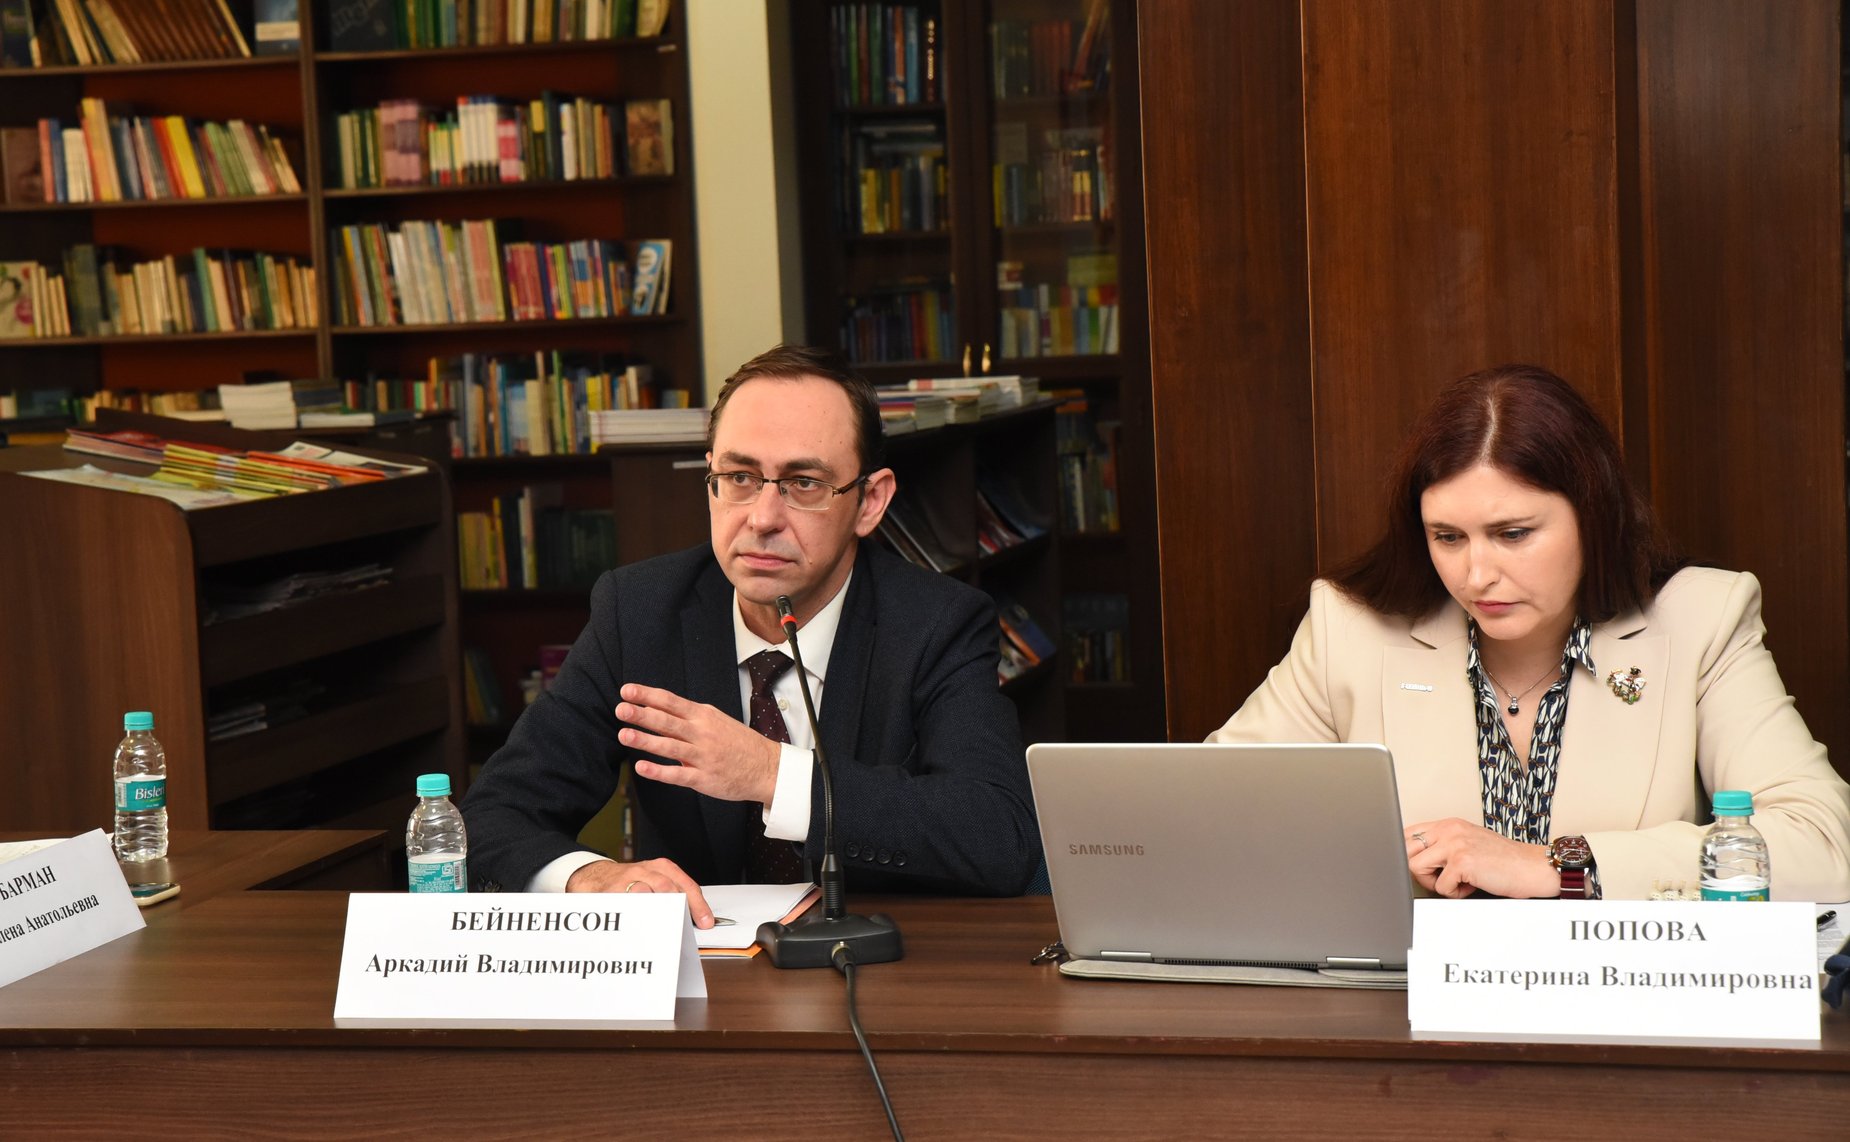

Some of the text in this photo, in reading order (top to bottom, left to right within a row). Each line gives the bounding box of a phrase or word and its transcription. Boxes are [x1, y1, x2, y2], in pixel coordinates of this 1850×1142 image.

[1068, 843, 1145, 856] SAMSUNG
[0, 865, 57, 901] БАРМАН
[25, 894, 99, 933] Анатольевна
[451, 906, 622, 932] БЕЙНЕНСОН
[1570, 919, 1708, 942] ПОПОВА
[365, 953, 653, 980] Аркадий Владимирович
[1443, 962, 1813, 995] Екатерина Владимировна
